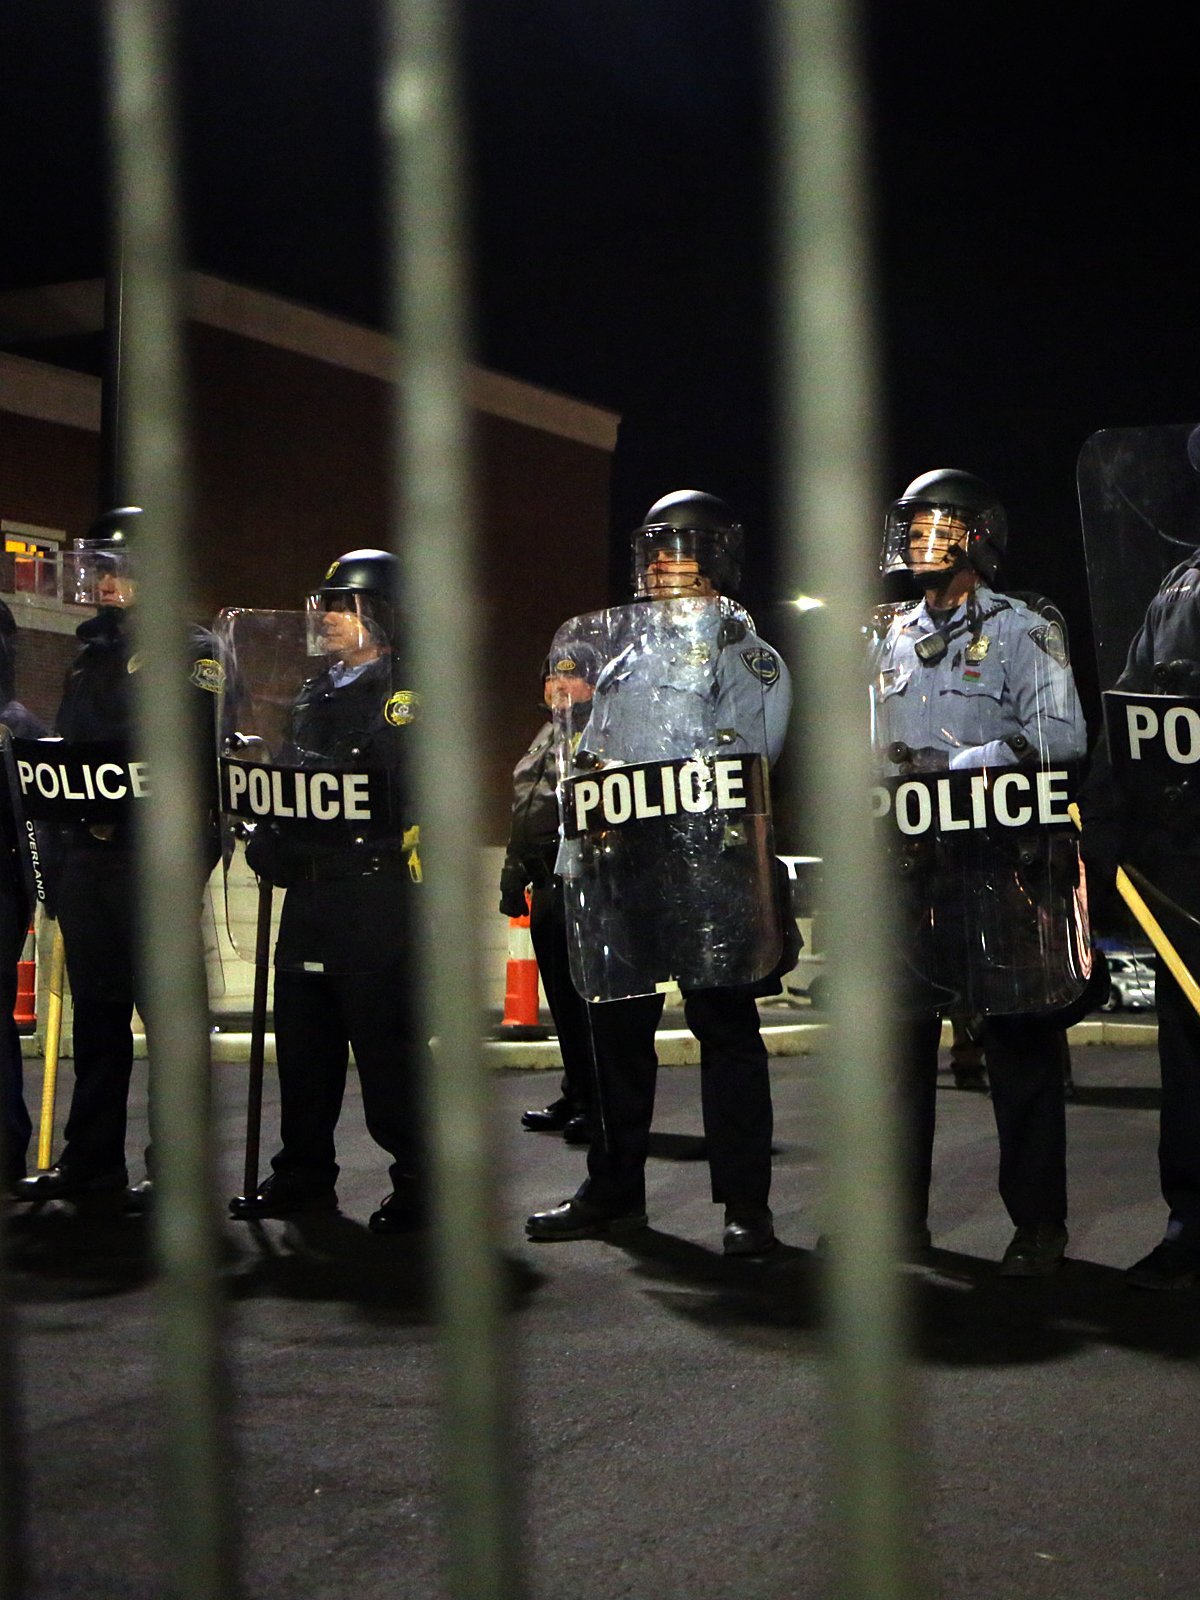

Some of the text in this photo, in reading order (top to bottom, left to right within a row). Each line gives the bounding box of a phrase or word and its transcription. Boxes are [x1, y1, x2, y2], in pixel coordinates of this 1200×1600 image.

[17, 760, 151, 800] POLICE
[229, 765, 372, 821] POLICE
[574, 759, 747, 832] POLICE
[26, 821, 46, 900] OVERLAND
